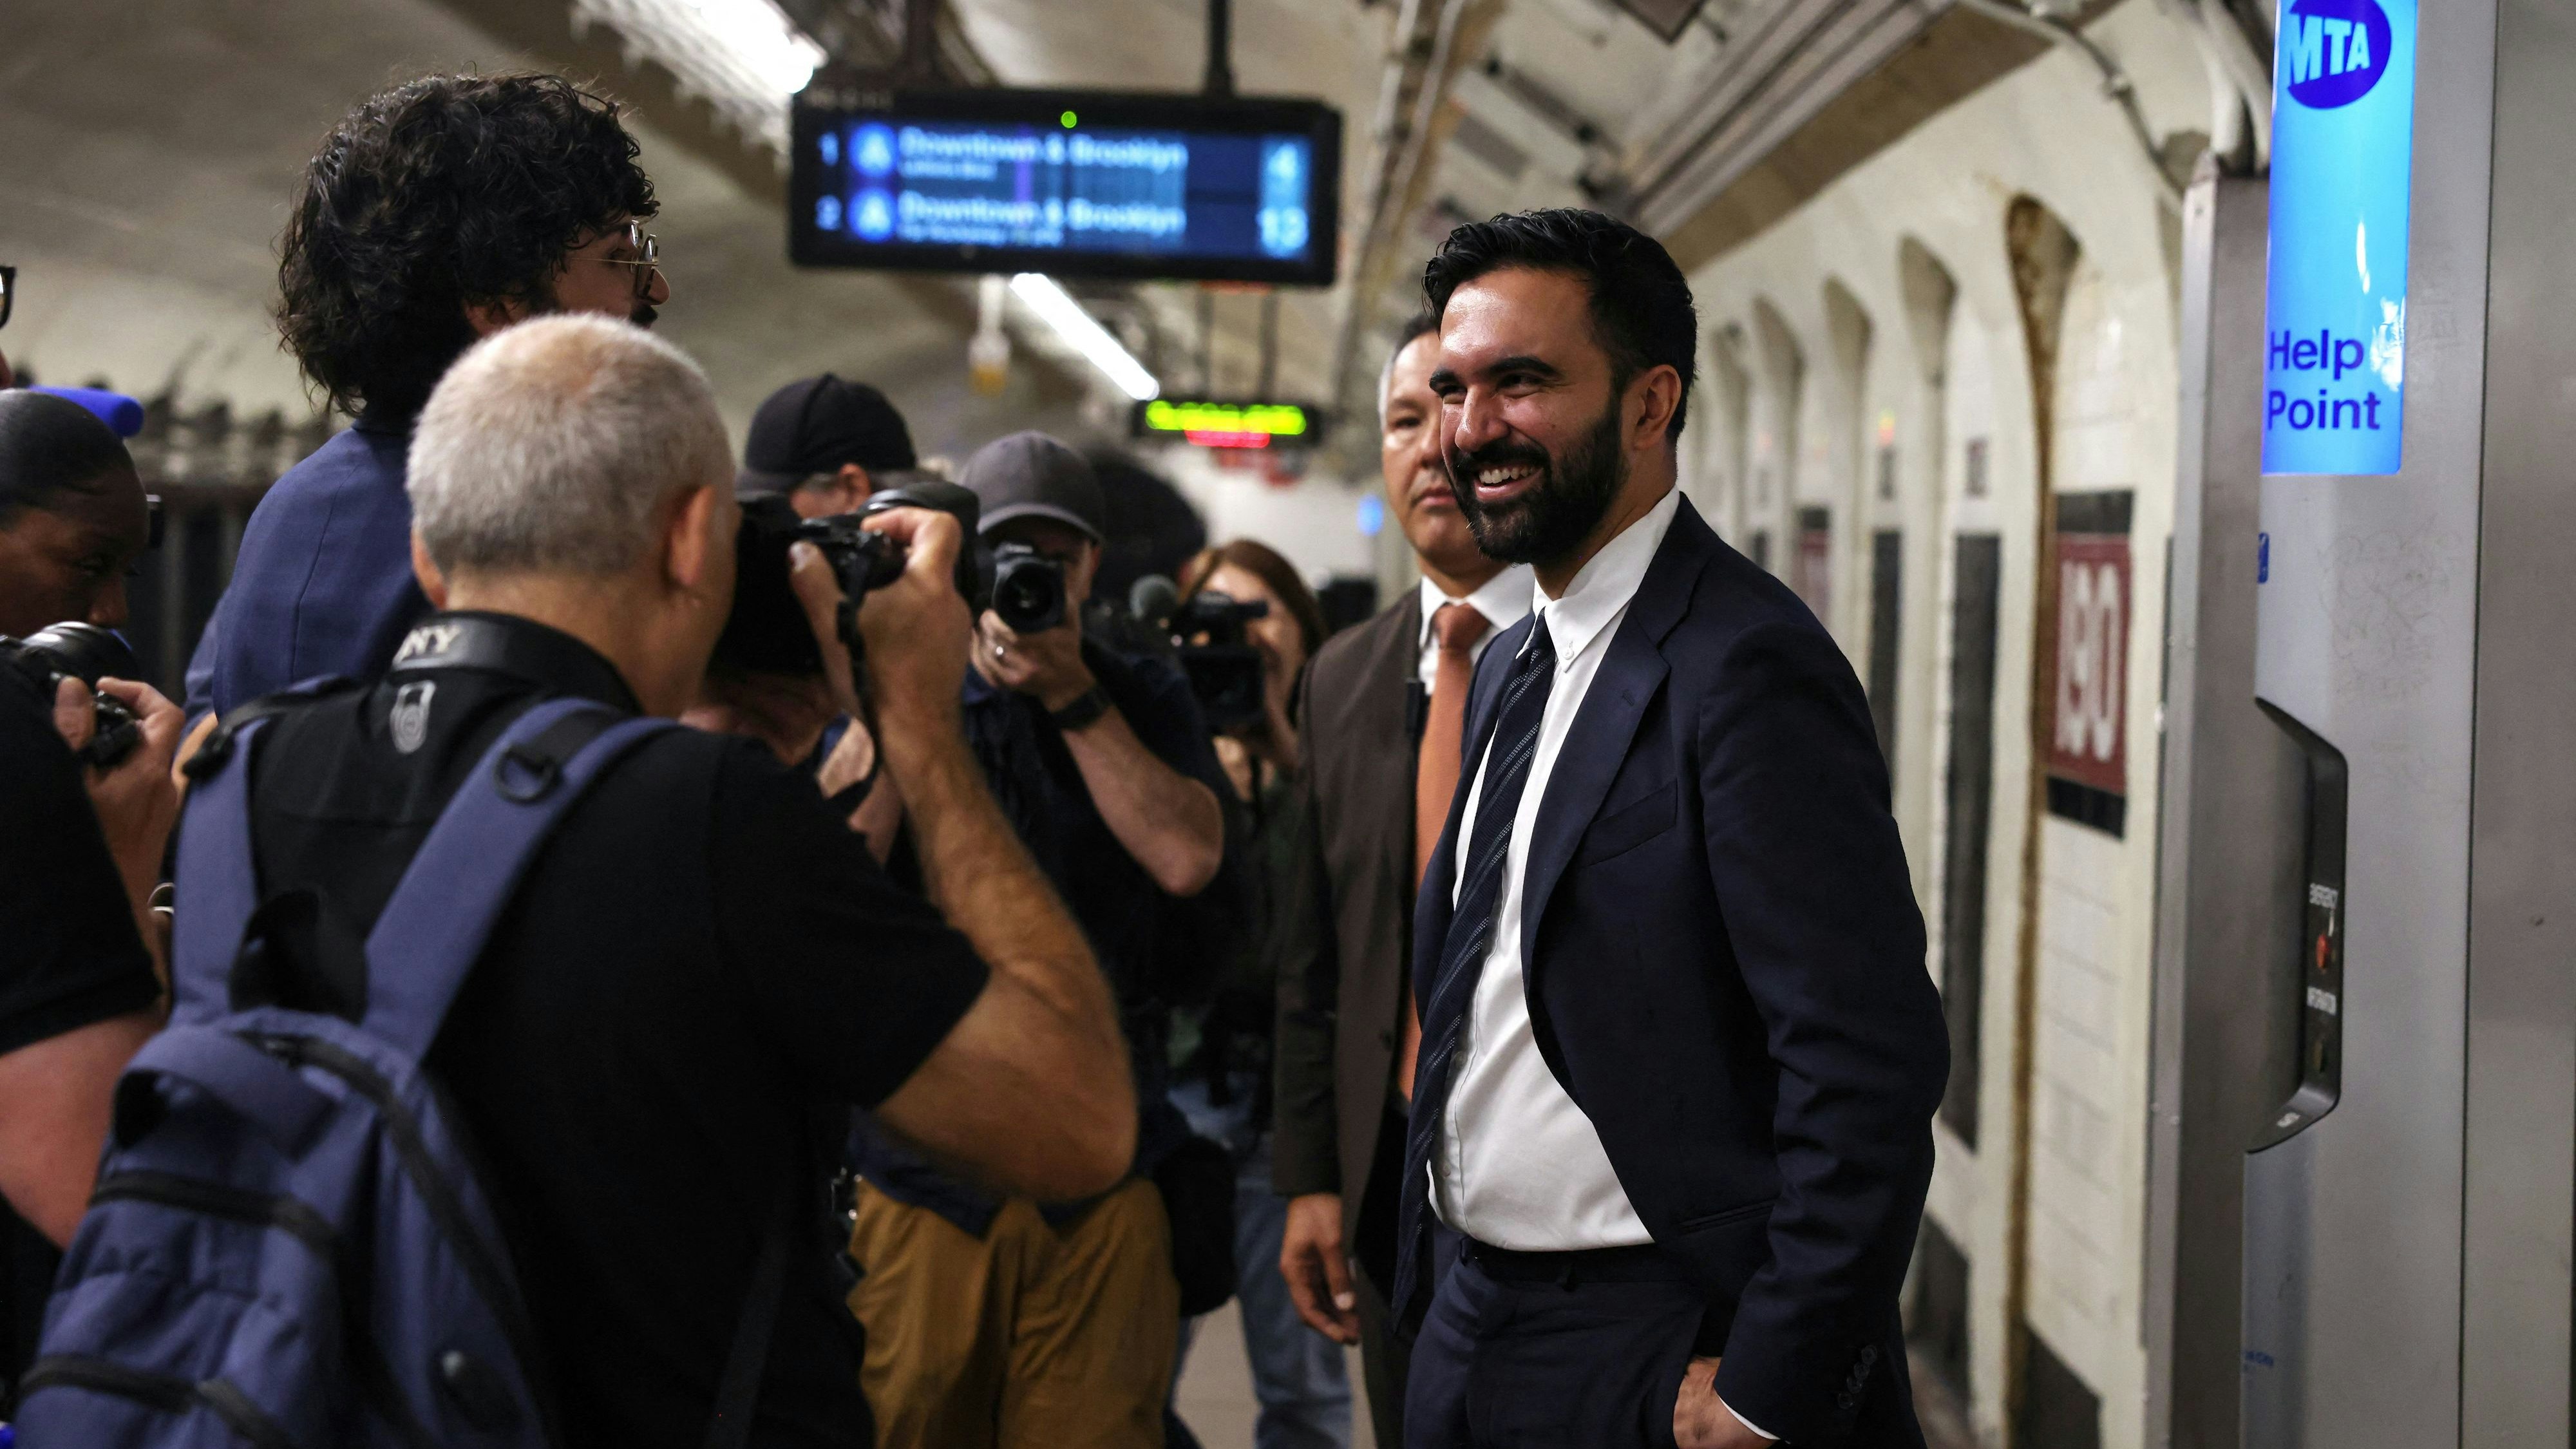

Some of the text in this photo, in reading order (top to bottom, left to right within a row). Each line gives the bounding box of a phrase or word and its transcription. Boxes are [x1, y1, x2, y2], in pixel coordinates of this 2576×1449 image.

[2289, 13, 2371, 85] MTA
[820, 133, 838, 165] 1
[900, 127, 1042, 161] Downtown
[1069, 134, 1188, 174] Brooklyn
[1267, 142, 1298, 179] 4
[816, 196, 842, 231] 2
[899, 191, 1041, 225] Downtown
[1066, 198, 1186, 237] Brooklyn
[2269, 329, 2364, 381] Help
[2267, 389, 2381, 431] Point
[2056, 561, 2120, 761] 190
